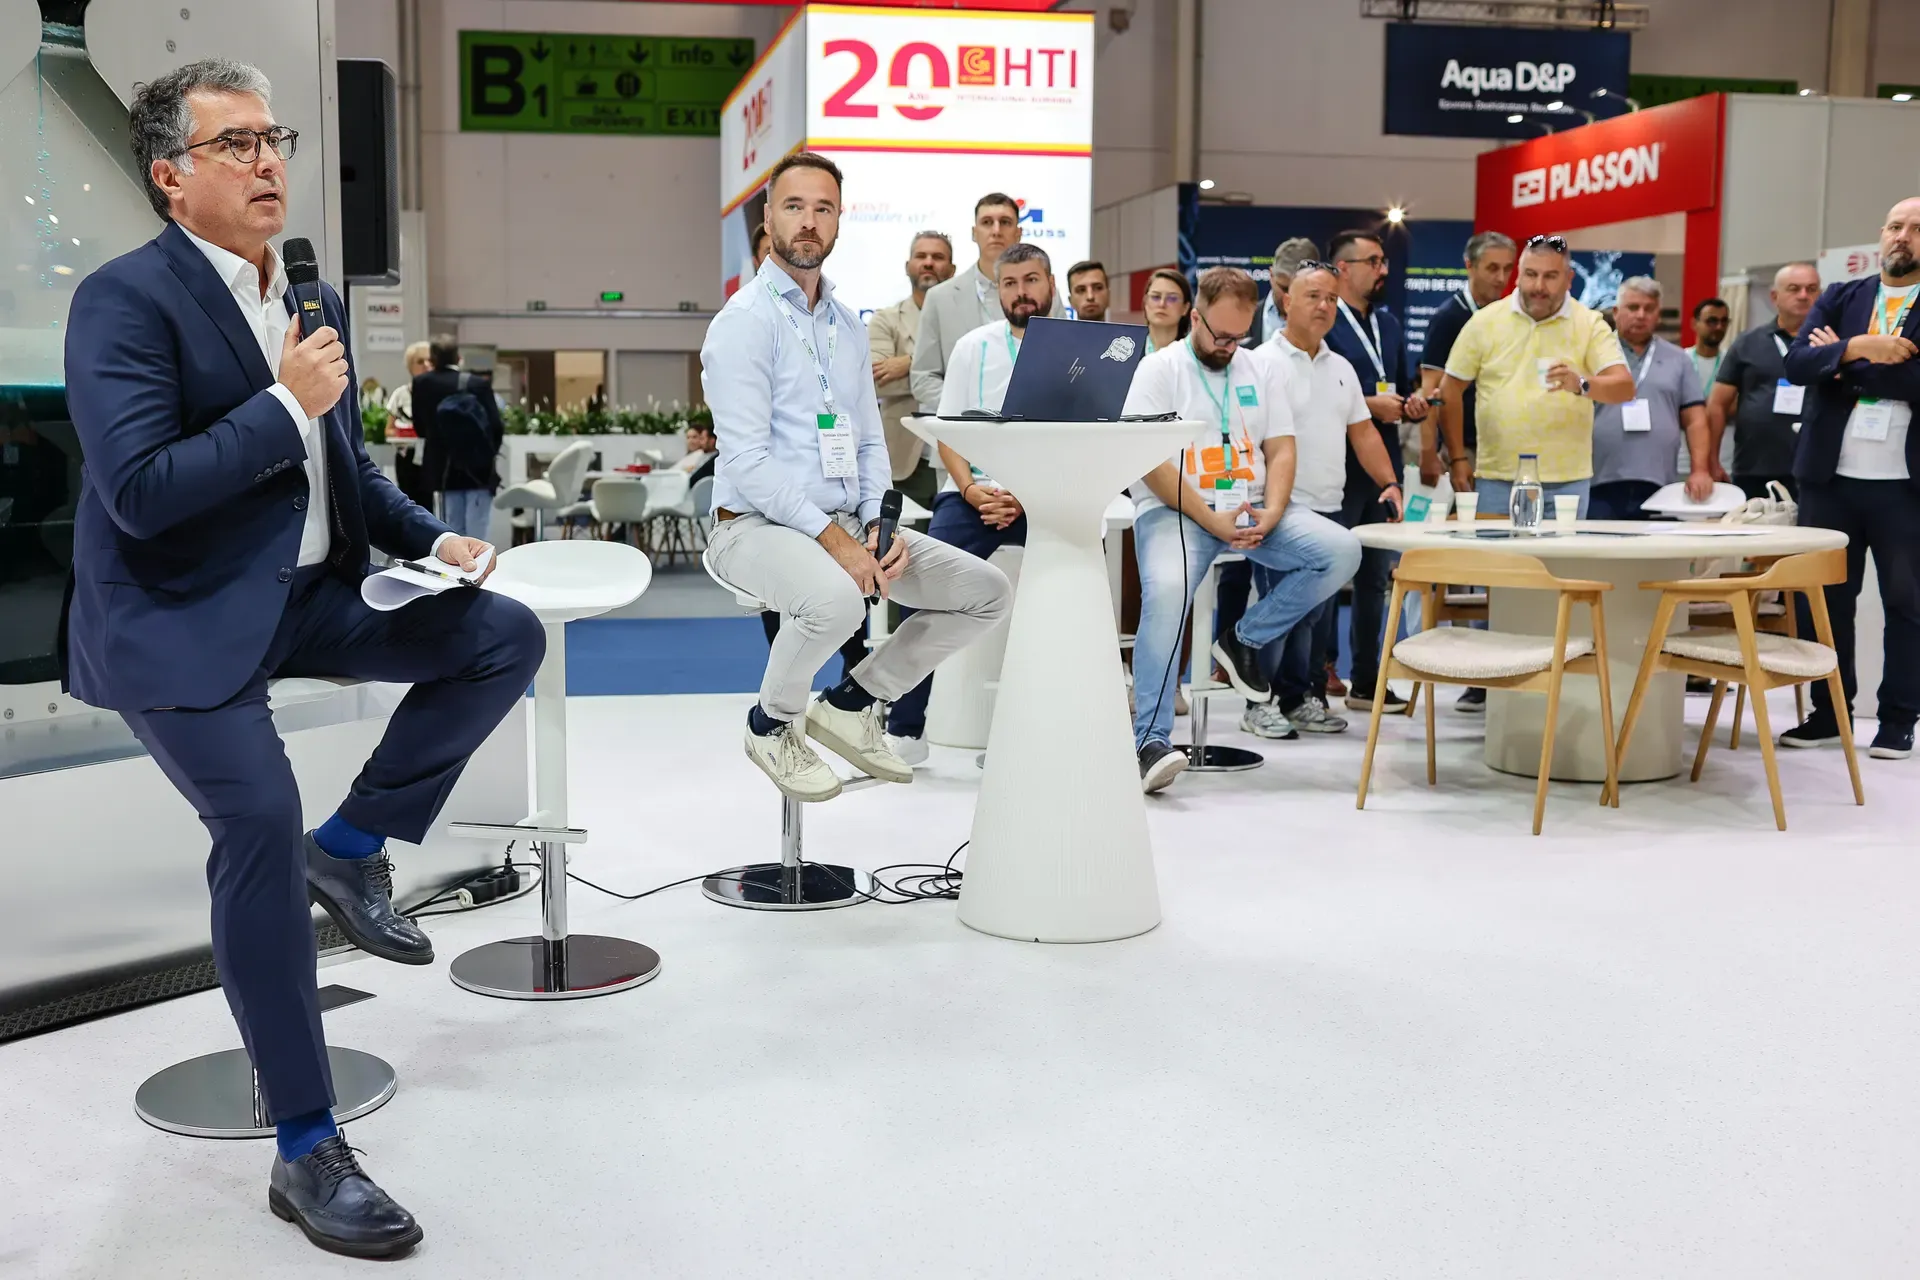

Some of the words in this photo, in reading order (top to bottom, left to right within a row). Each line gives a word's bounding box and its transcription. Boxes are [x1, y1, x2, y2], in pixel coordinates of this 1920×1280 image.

[823, 40, 950, 121] 20
[1004, 48, 1077, 88] HTI
[1441, 59, 1513, 96] Aqua
[1515, 62, 1576, 93] D&P
[667, 108, 720, 128] EXIT
[1550, 143, 1660, 201] PLASSON
